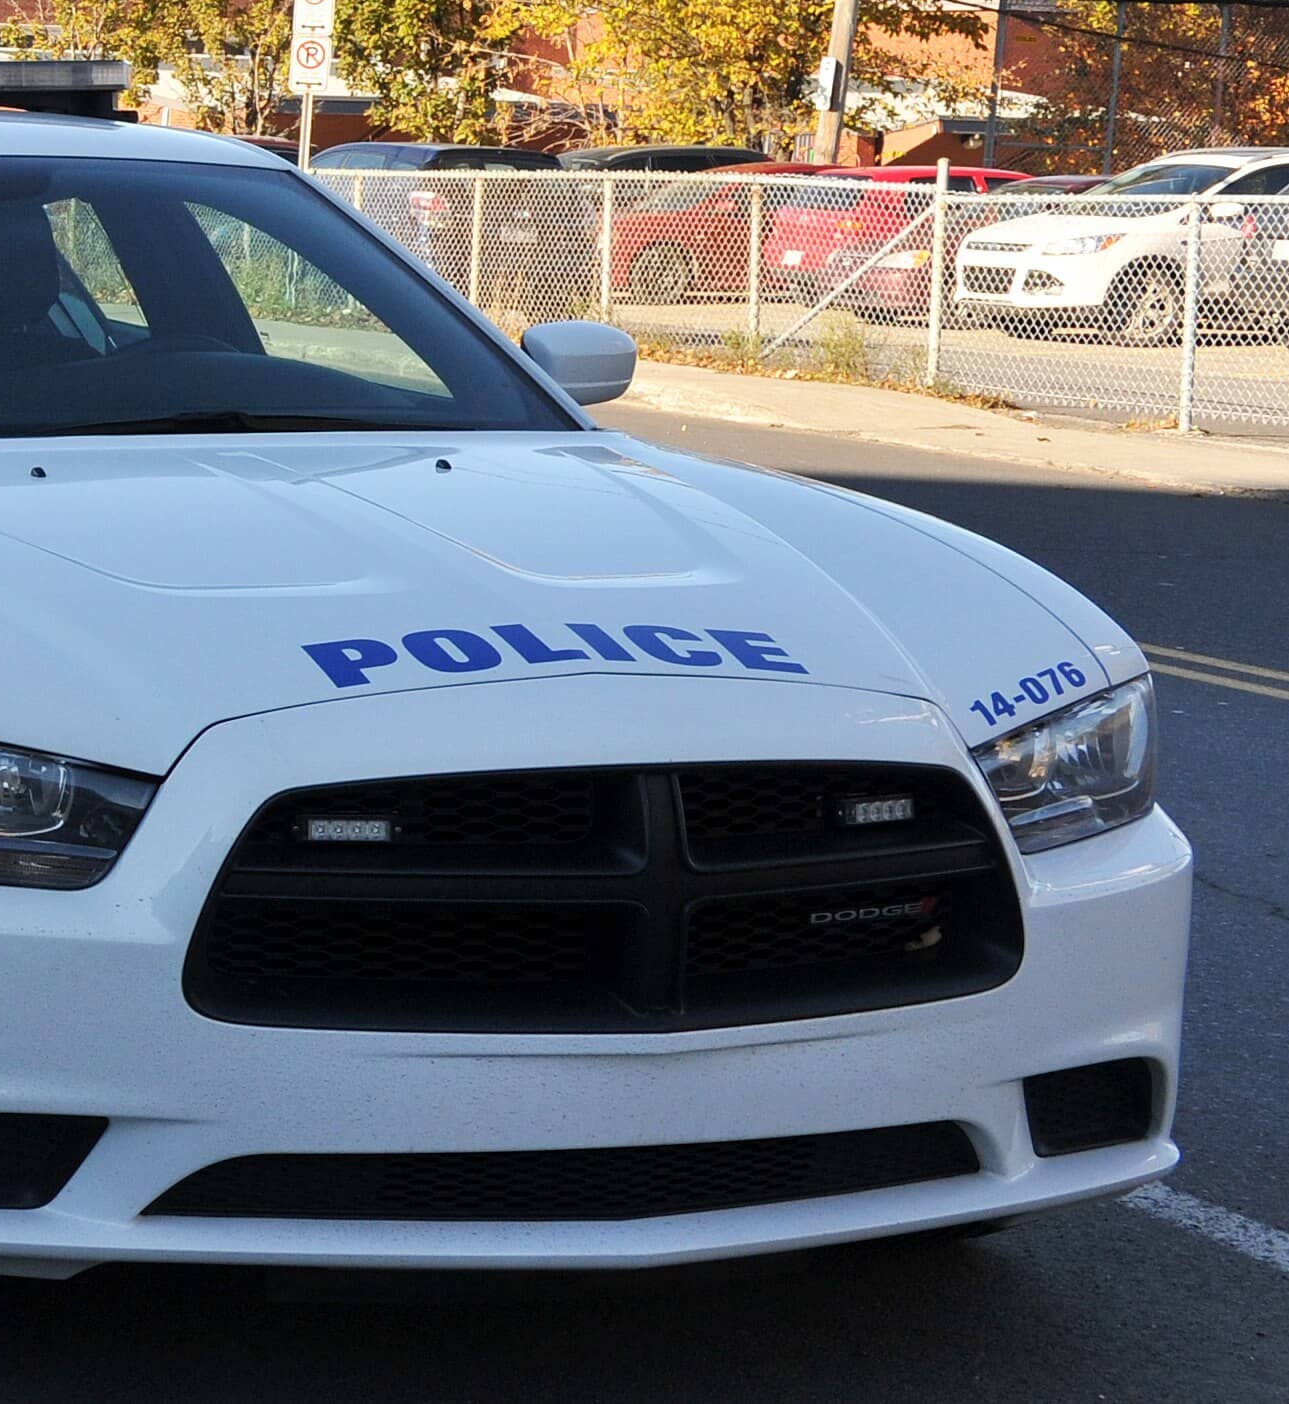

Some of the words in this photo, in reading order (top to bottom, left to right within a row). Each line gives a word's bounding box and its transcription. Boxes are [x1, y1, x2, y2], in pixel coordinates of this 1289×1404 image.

[301, 622, 811, 688] POLICE
[969, 661, 1087, 727] 14-076
[810, 903, 921, 924] DODGE
